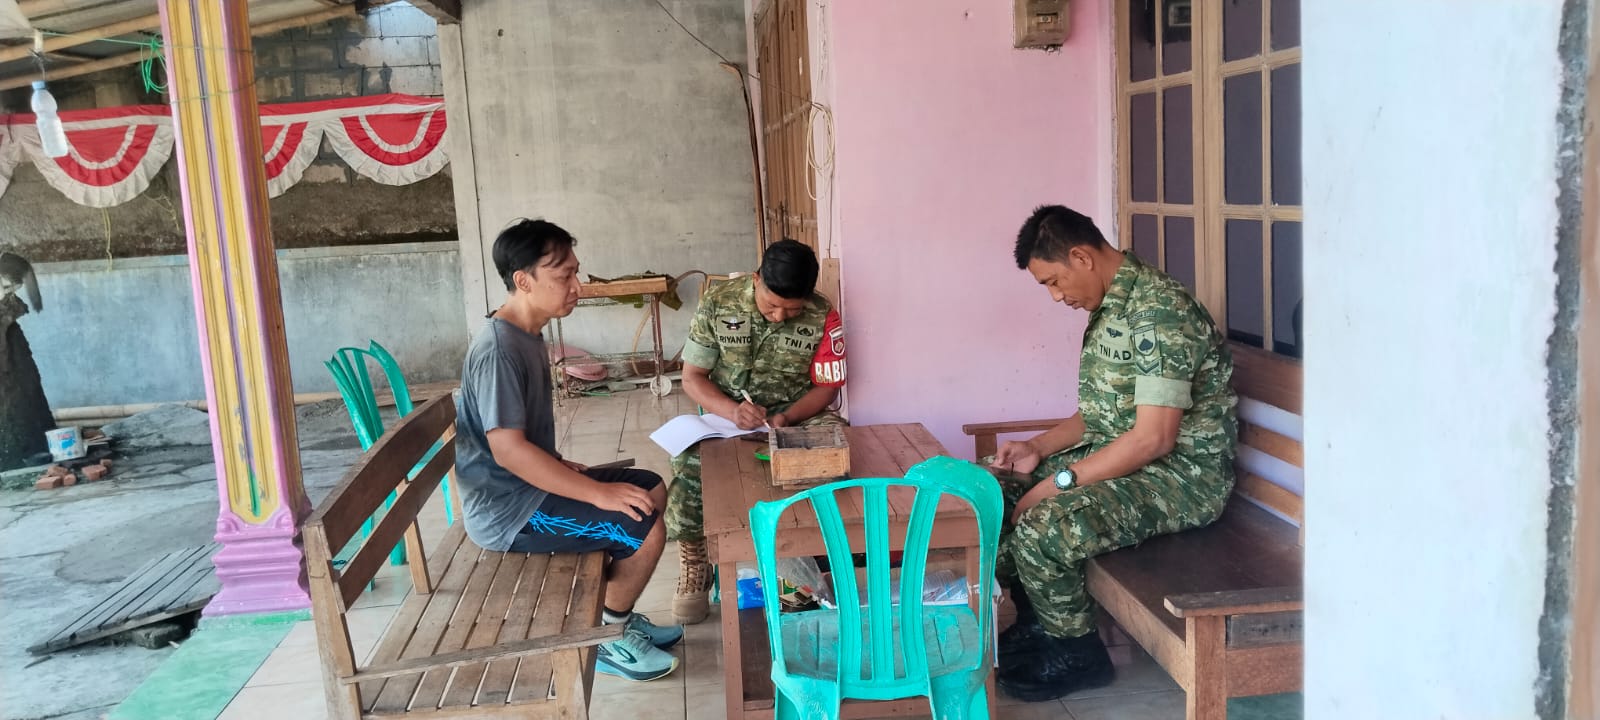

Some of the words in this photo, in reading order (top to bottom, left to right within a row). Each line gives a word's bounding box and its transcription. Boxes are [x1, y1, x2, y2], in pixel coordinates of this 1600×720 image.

[785, 336, 802, 348] TNI
[1099, 343, 1111, 358] TNI
[1113, 350, 1132, 361] AD
